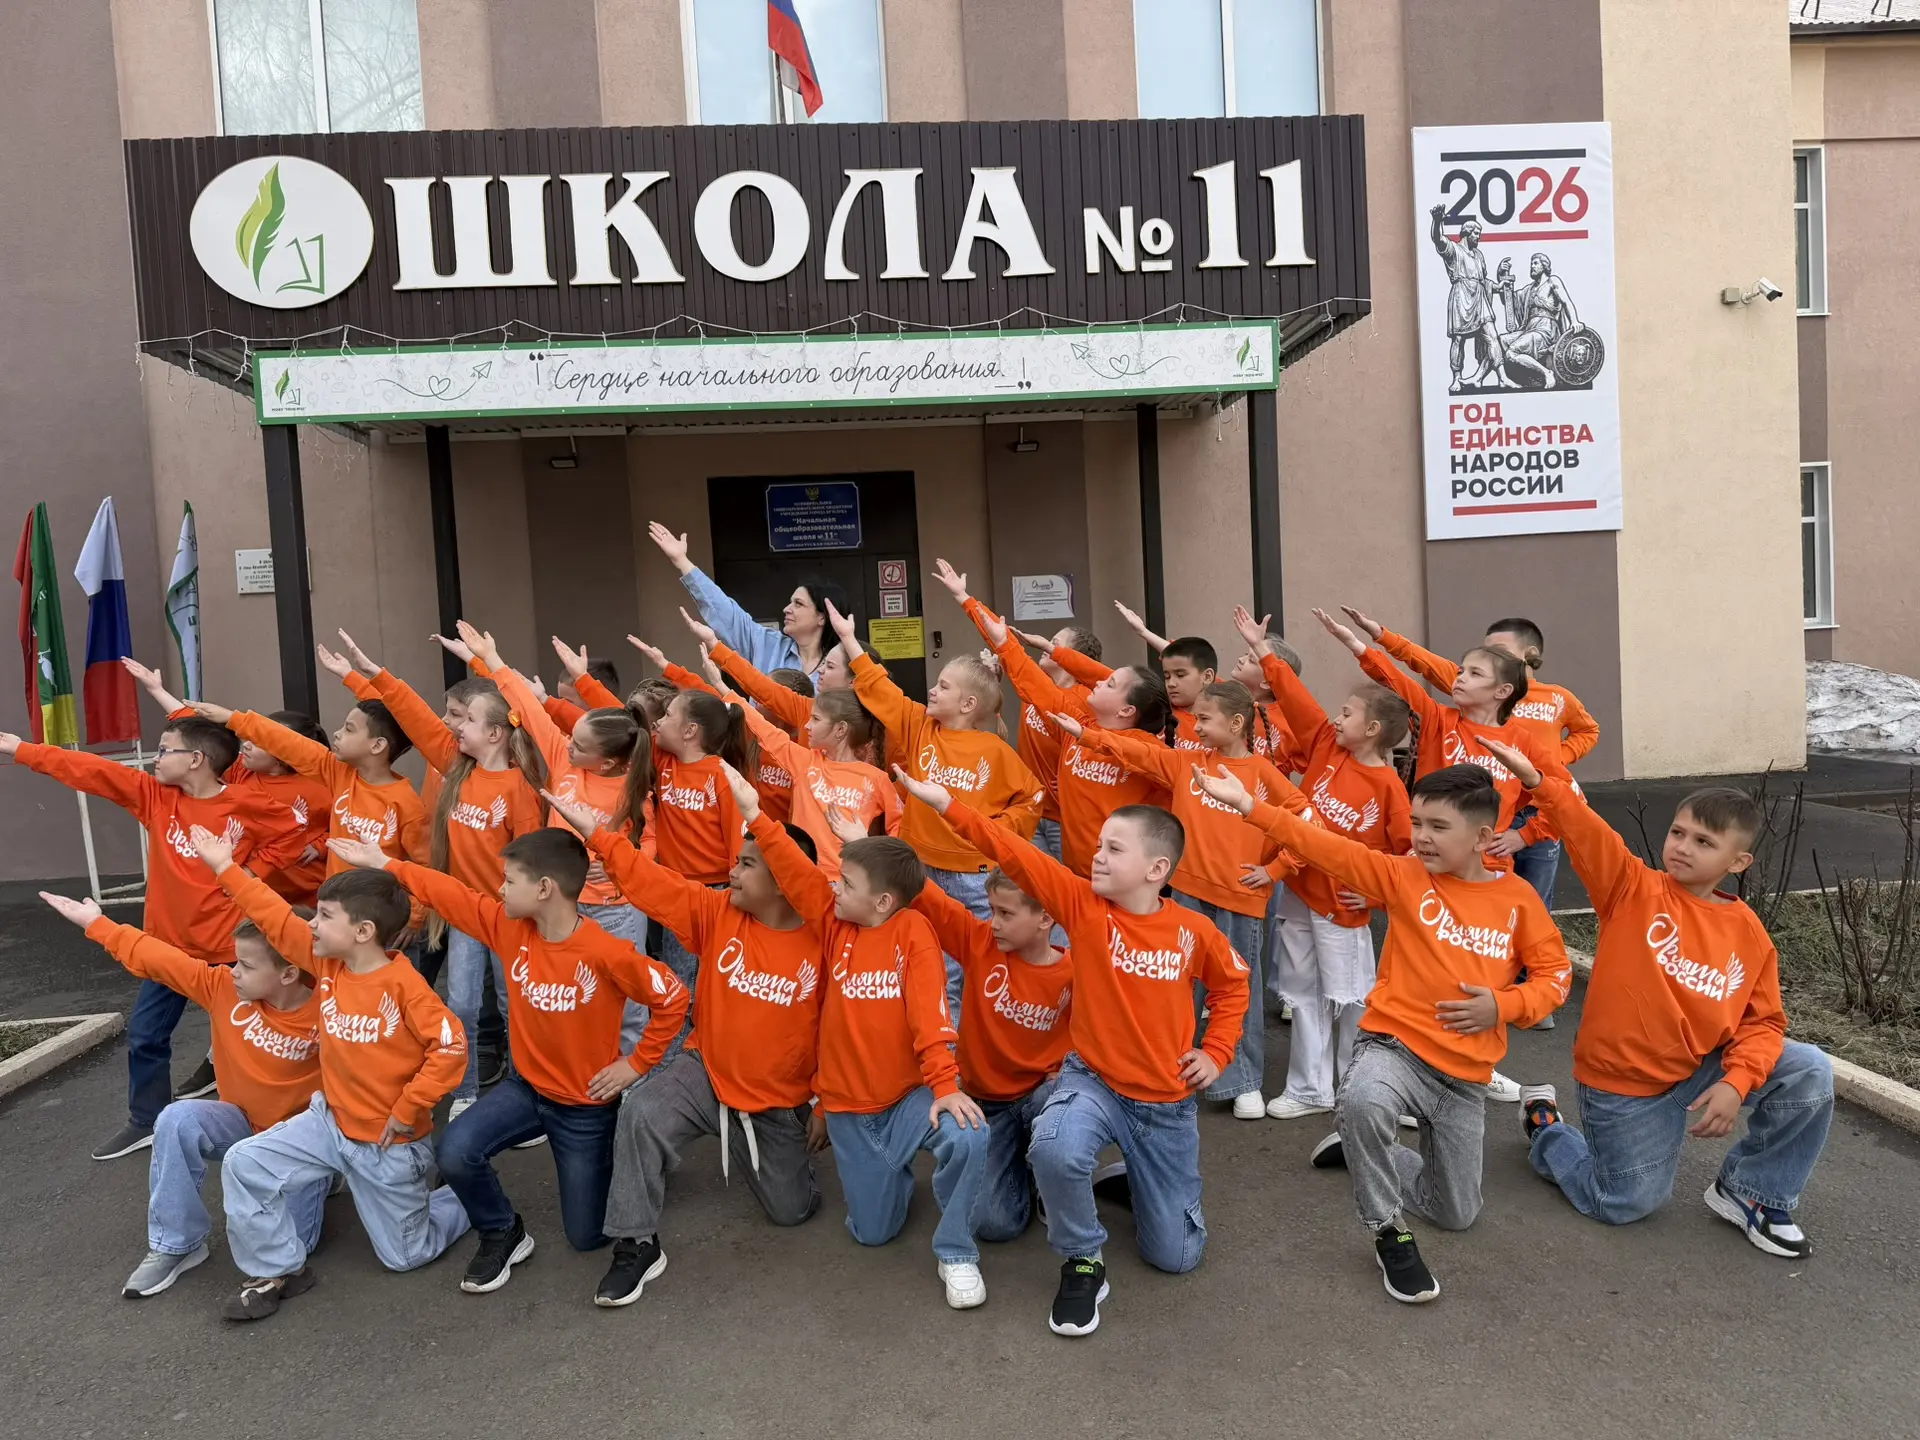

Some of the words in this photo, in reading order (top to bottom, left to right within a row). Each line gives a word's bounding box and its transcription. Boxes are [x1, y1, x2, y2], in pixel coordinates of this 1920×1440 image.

[1440, 166, 1589, 226] 2026
[383, 167, 1056, 290] ШКОЛА
[1083, 206, 1174, 274] №
[1193, 159, 1316, 269] 11
[659, 367, 821, 387] начального
[1449, 402, 1503, 425] ГОД
[1450, 423, 1595, 451] ЕДИНСТВА
[1451, 449, 1580, 474] НАРОДОВ
[1452, 474, 1564, 499] РОССИИ
[774, 523, 856, 534] общеобразовательная
[792, 533, 817, 541] школа
[1419, 889, 1511, 948] Орлята
[1647, 913, 1727, 988] Орлята
[718, 937, 797, 994] Орлята
[728, 976, 793, 1007] РОССИИ
[984, 964, 1057, 1020] Орлята
